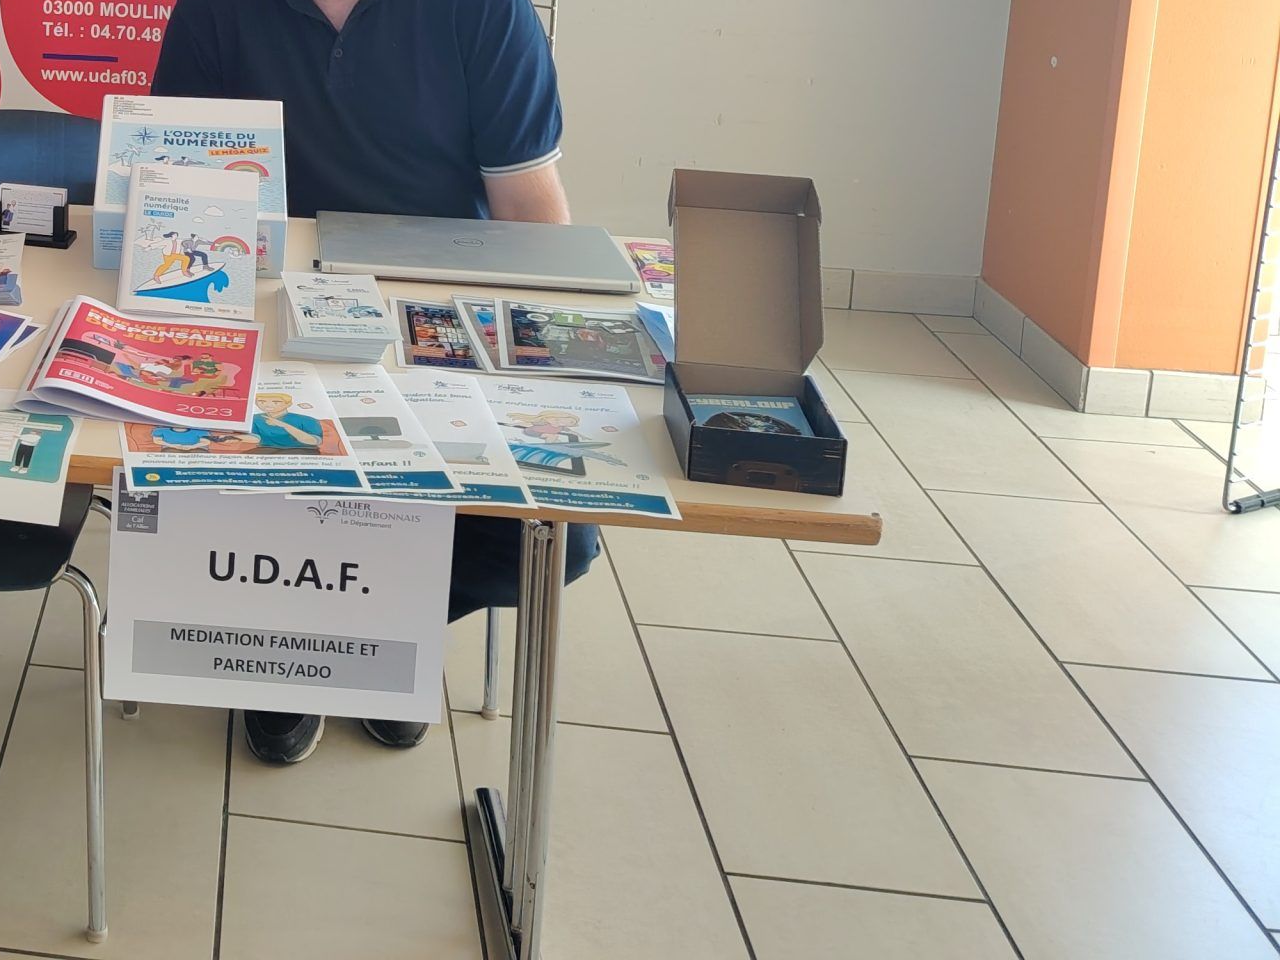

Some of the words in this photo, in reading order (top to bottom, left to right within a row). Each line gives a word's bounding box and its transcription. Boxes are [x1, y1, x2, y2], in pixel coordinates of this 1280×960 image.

[43, 0, 94, 16] 03000
[100, 2, 172, 20] MOULIN
[42, 22, 73, 37] Tél.
[90, 24, 162, 42] 04.70.48
[41, 68, 152, 86] www.udaf03.
[163, 129, 232, 140] L'ODYSSÉE
[237, 132, 256, 140] DU
[163, 137, 257, 149] NUMÉRIQUE
[144, 194, 190, 205] Parentalité
[143, 202, 189, 212] numérique
[87, 311, 247, 344] RESPONSABLE
[135, 324, 166, 332] UNE
[170, 327, 247, 338] PRATIQUE
[176, 403, 233, 417] 2023
[334, 500, 371, 511] ALLIER
[131, 515, 145, 523] Caf
[341, 508, 422, 524] BOURBONNAIS
[340, 518, 349, 526] Le
[350, 519, 392, 529] Département
[209, 550, 370, 594] U.D.A.F.
[170, 627, 265, 648] MEDIATION
[270, 635, 355, 655] FAMILIALE
[360, 643, 380, 657] ET
[213, 657, 332, 679] PARENTS/ADO
